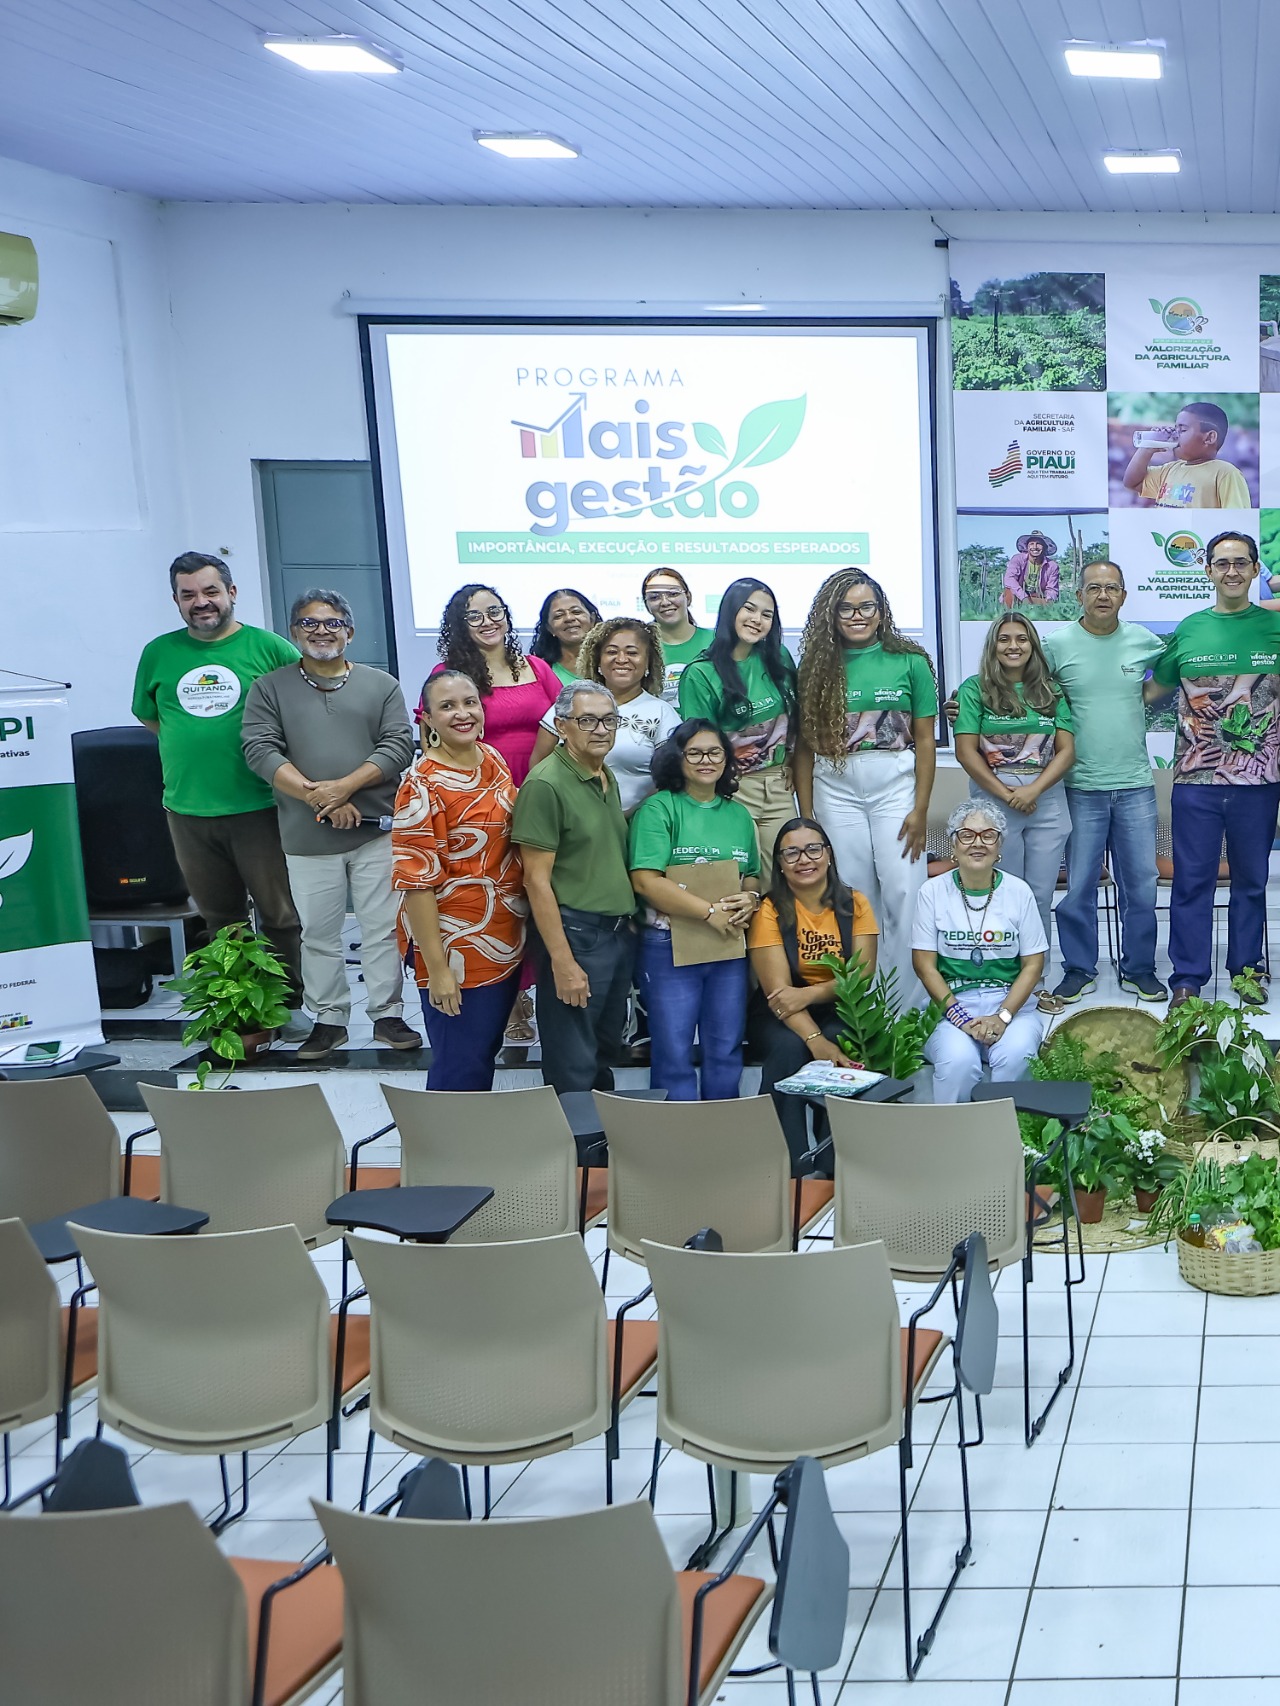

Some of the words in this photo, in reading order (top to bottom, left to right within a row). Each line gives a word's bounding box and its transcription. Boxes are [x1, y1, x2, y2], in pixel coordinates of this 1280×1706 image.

[1145, 345, 1221, 354] VALORIZAÇÃO
[516, 367, 686, 387] PROGRAMA
[525, 465, 760, 537] gestão
[468, 540, 575, 555] IMPORTÂNCIA,
[579, 540, 658, 556] EXECUÇÃO
[662, 542, 671, 553] E
[674, 542, 770, 554] RESULTADOS
[773, 542, 861, 554] ESPERADOS
[1148, 577, 1214, 585] VALORIZAÇ
[182, 685, 234, 694] QUITANDA
[806, 930, 835, 945] Girls
[9, 979, 37, 988] FEDERAL
